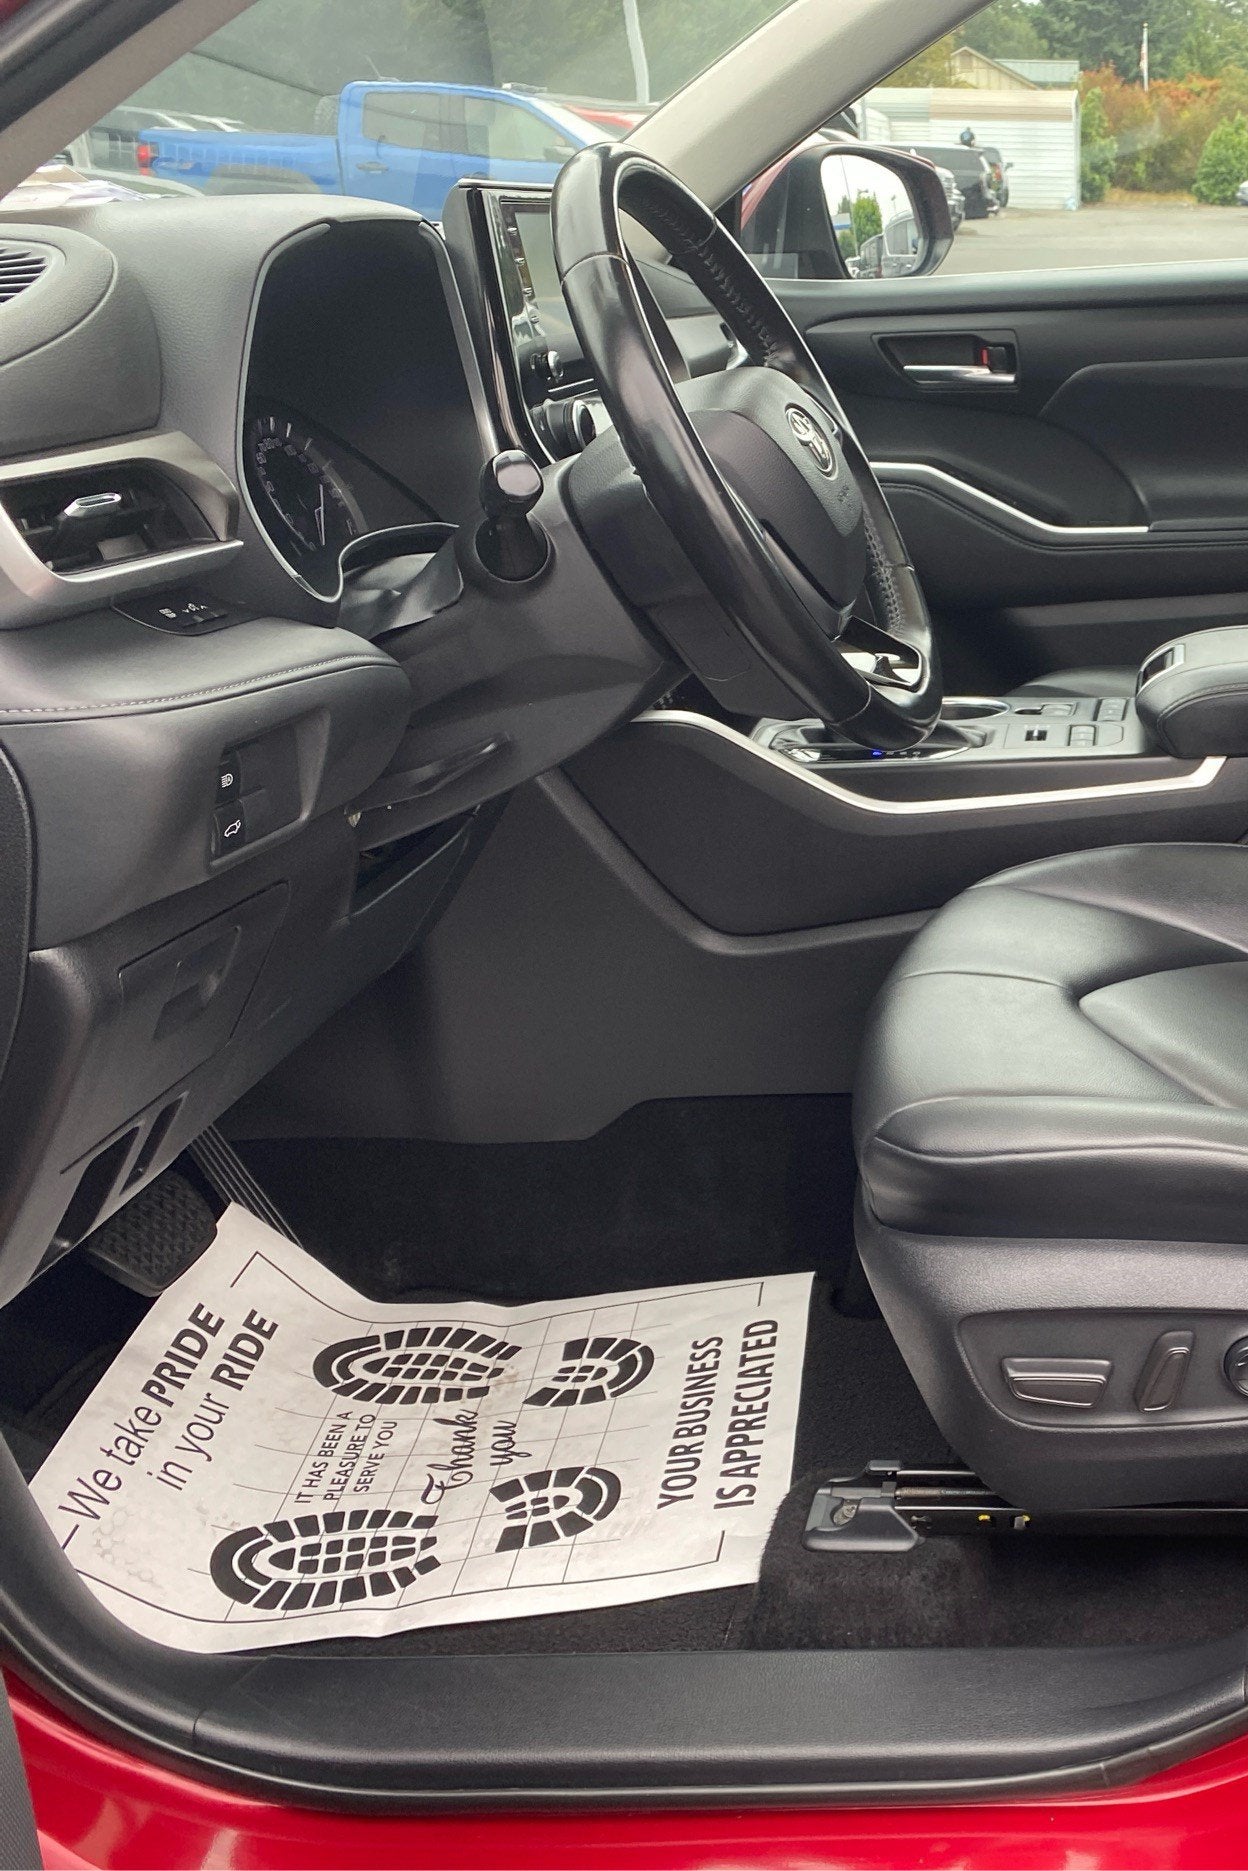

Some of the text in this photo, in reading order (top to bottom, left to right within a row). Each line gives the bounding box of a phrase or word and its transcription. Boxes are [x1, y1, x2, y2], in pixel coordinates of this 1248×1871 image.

[58, 1302, 225, 1520] We take PRIDE
[147, 1308, 279, 1491] in your RIDE
[489, 1420, 533, 1466] you
[657, 1336, 724, 1510] YOUR BUSINESS
[713, 1319, 779, 1510] IS APPRECIATED
[294, 1411, 354, 1504] IT HAS BEEN A
[322, 1414, 376, 1501] PLEASURE TO
[353, 1421, 398, 1493] SERVE YOU
[420, 1409, 479, 1504] Thank
